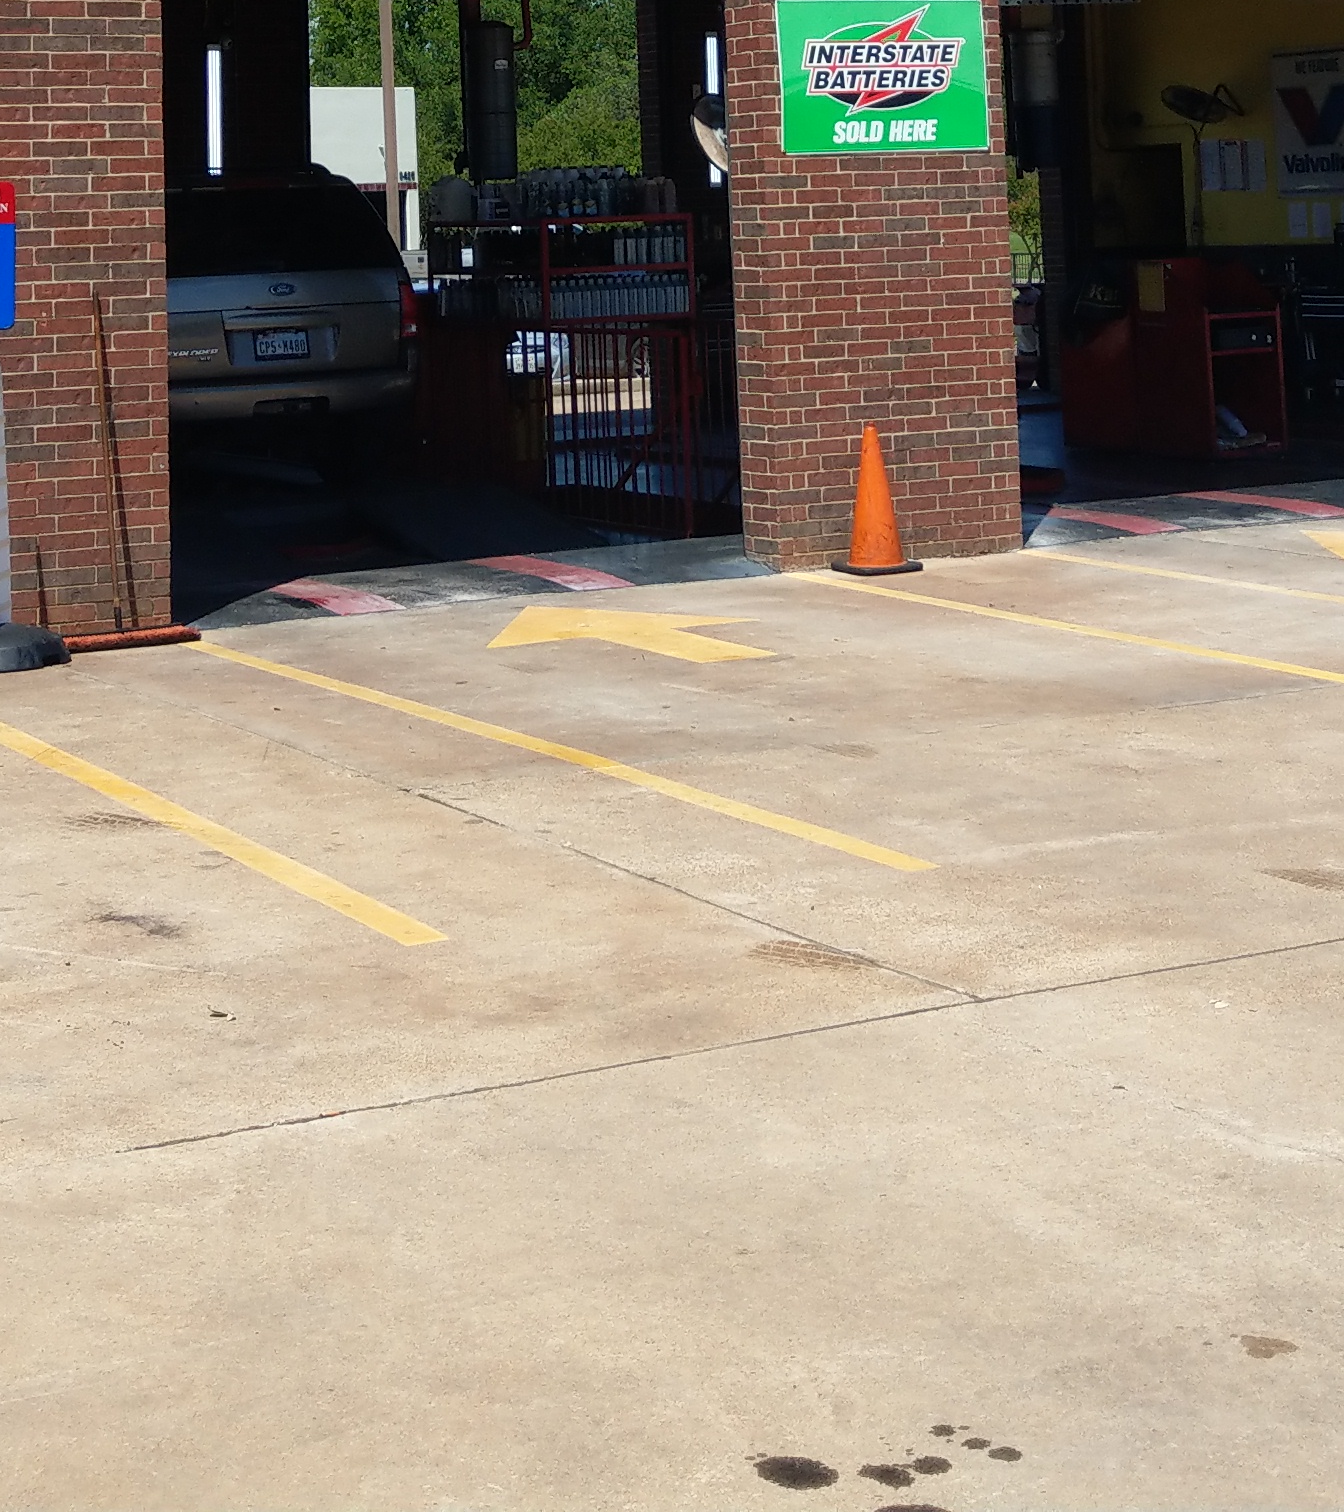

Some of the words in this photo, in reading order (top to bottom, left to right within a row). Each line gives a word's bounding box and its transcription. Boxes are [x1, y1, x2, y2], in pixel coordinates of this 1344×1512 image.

[808, 43, 956, 64] INTERSTATE
[813, 68, 947, 89] BATTERIES
[832, 120, 885, 144] SOLD
[888, 119, 939, 143] HERE
